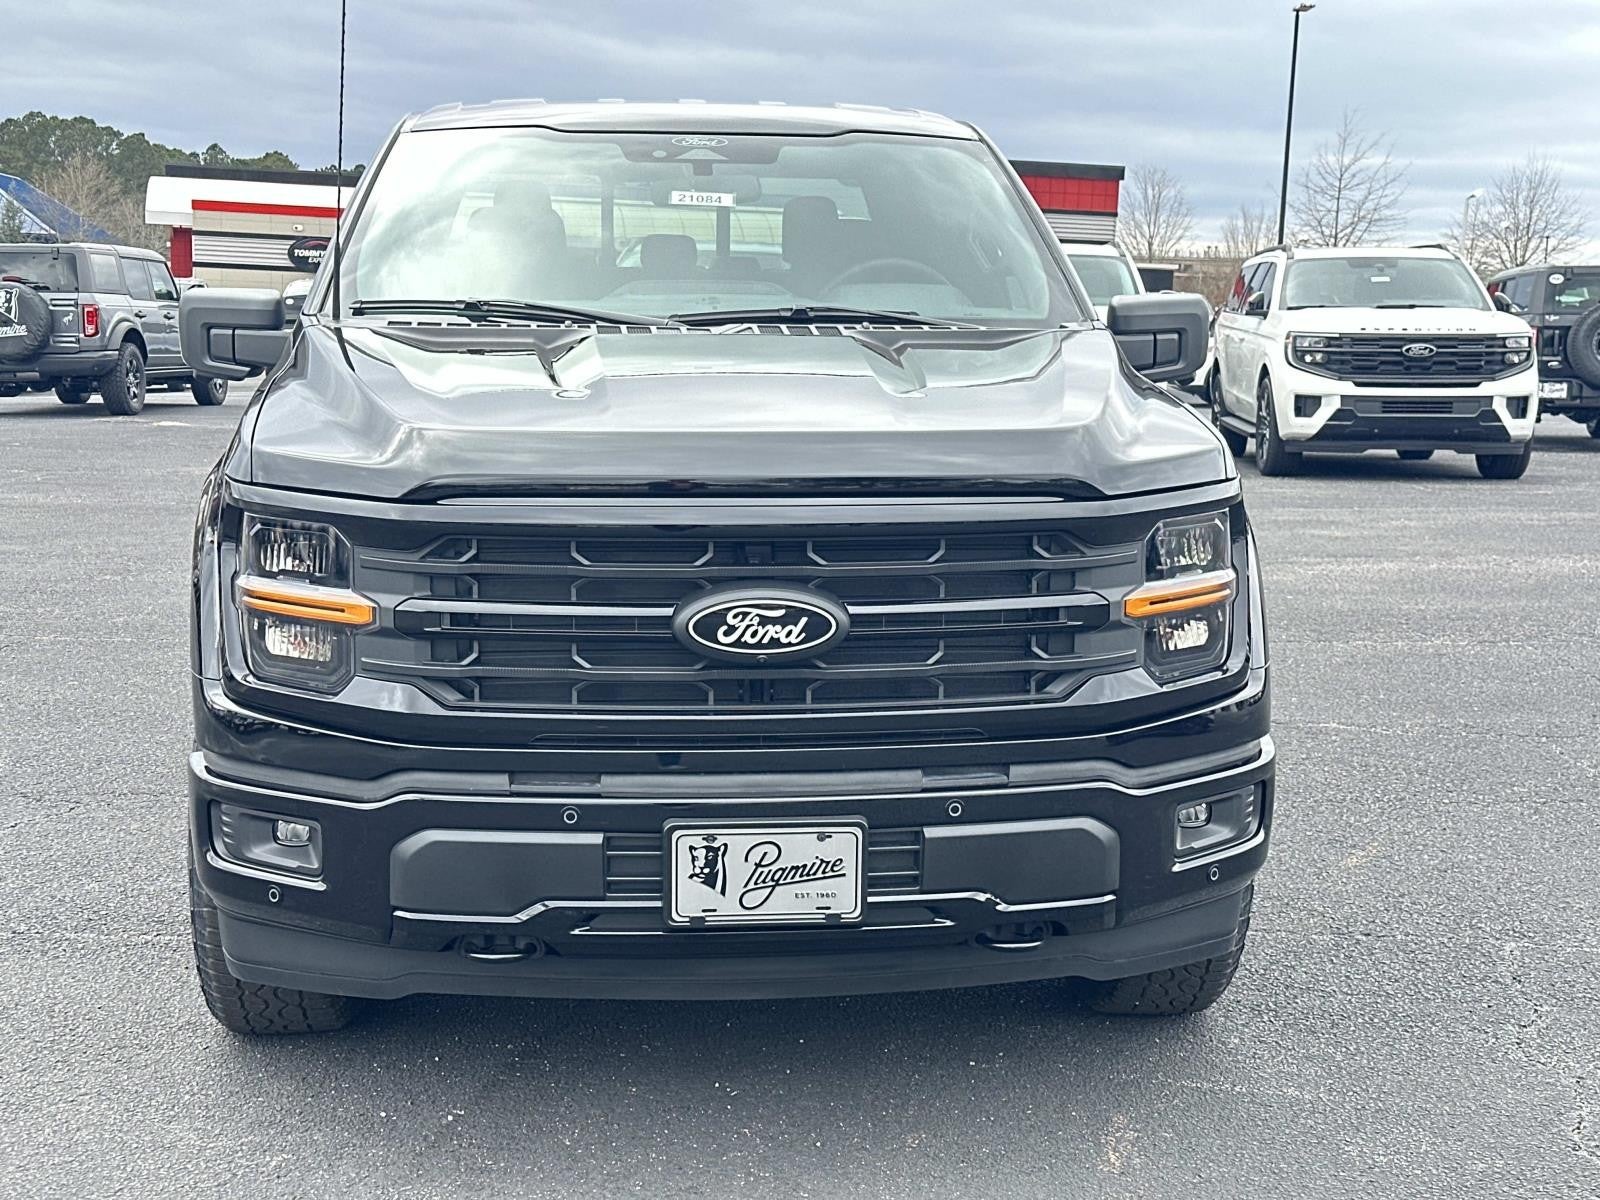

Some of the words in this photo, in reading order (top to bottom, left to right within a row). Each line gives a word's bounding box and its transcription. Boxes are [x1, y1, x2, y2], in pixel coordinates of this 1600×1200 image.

[681, 136, 719, 146] Ford
[677, 193, 722, 204] 21084
[294, 249, 325, 258] TOMMY
[717, 607, 808, 644] Ford
[739, 840, 846, 910] Pugmire
